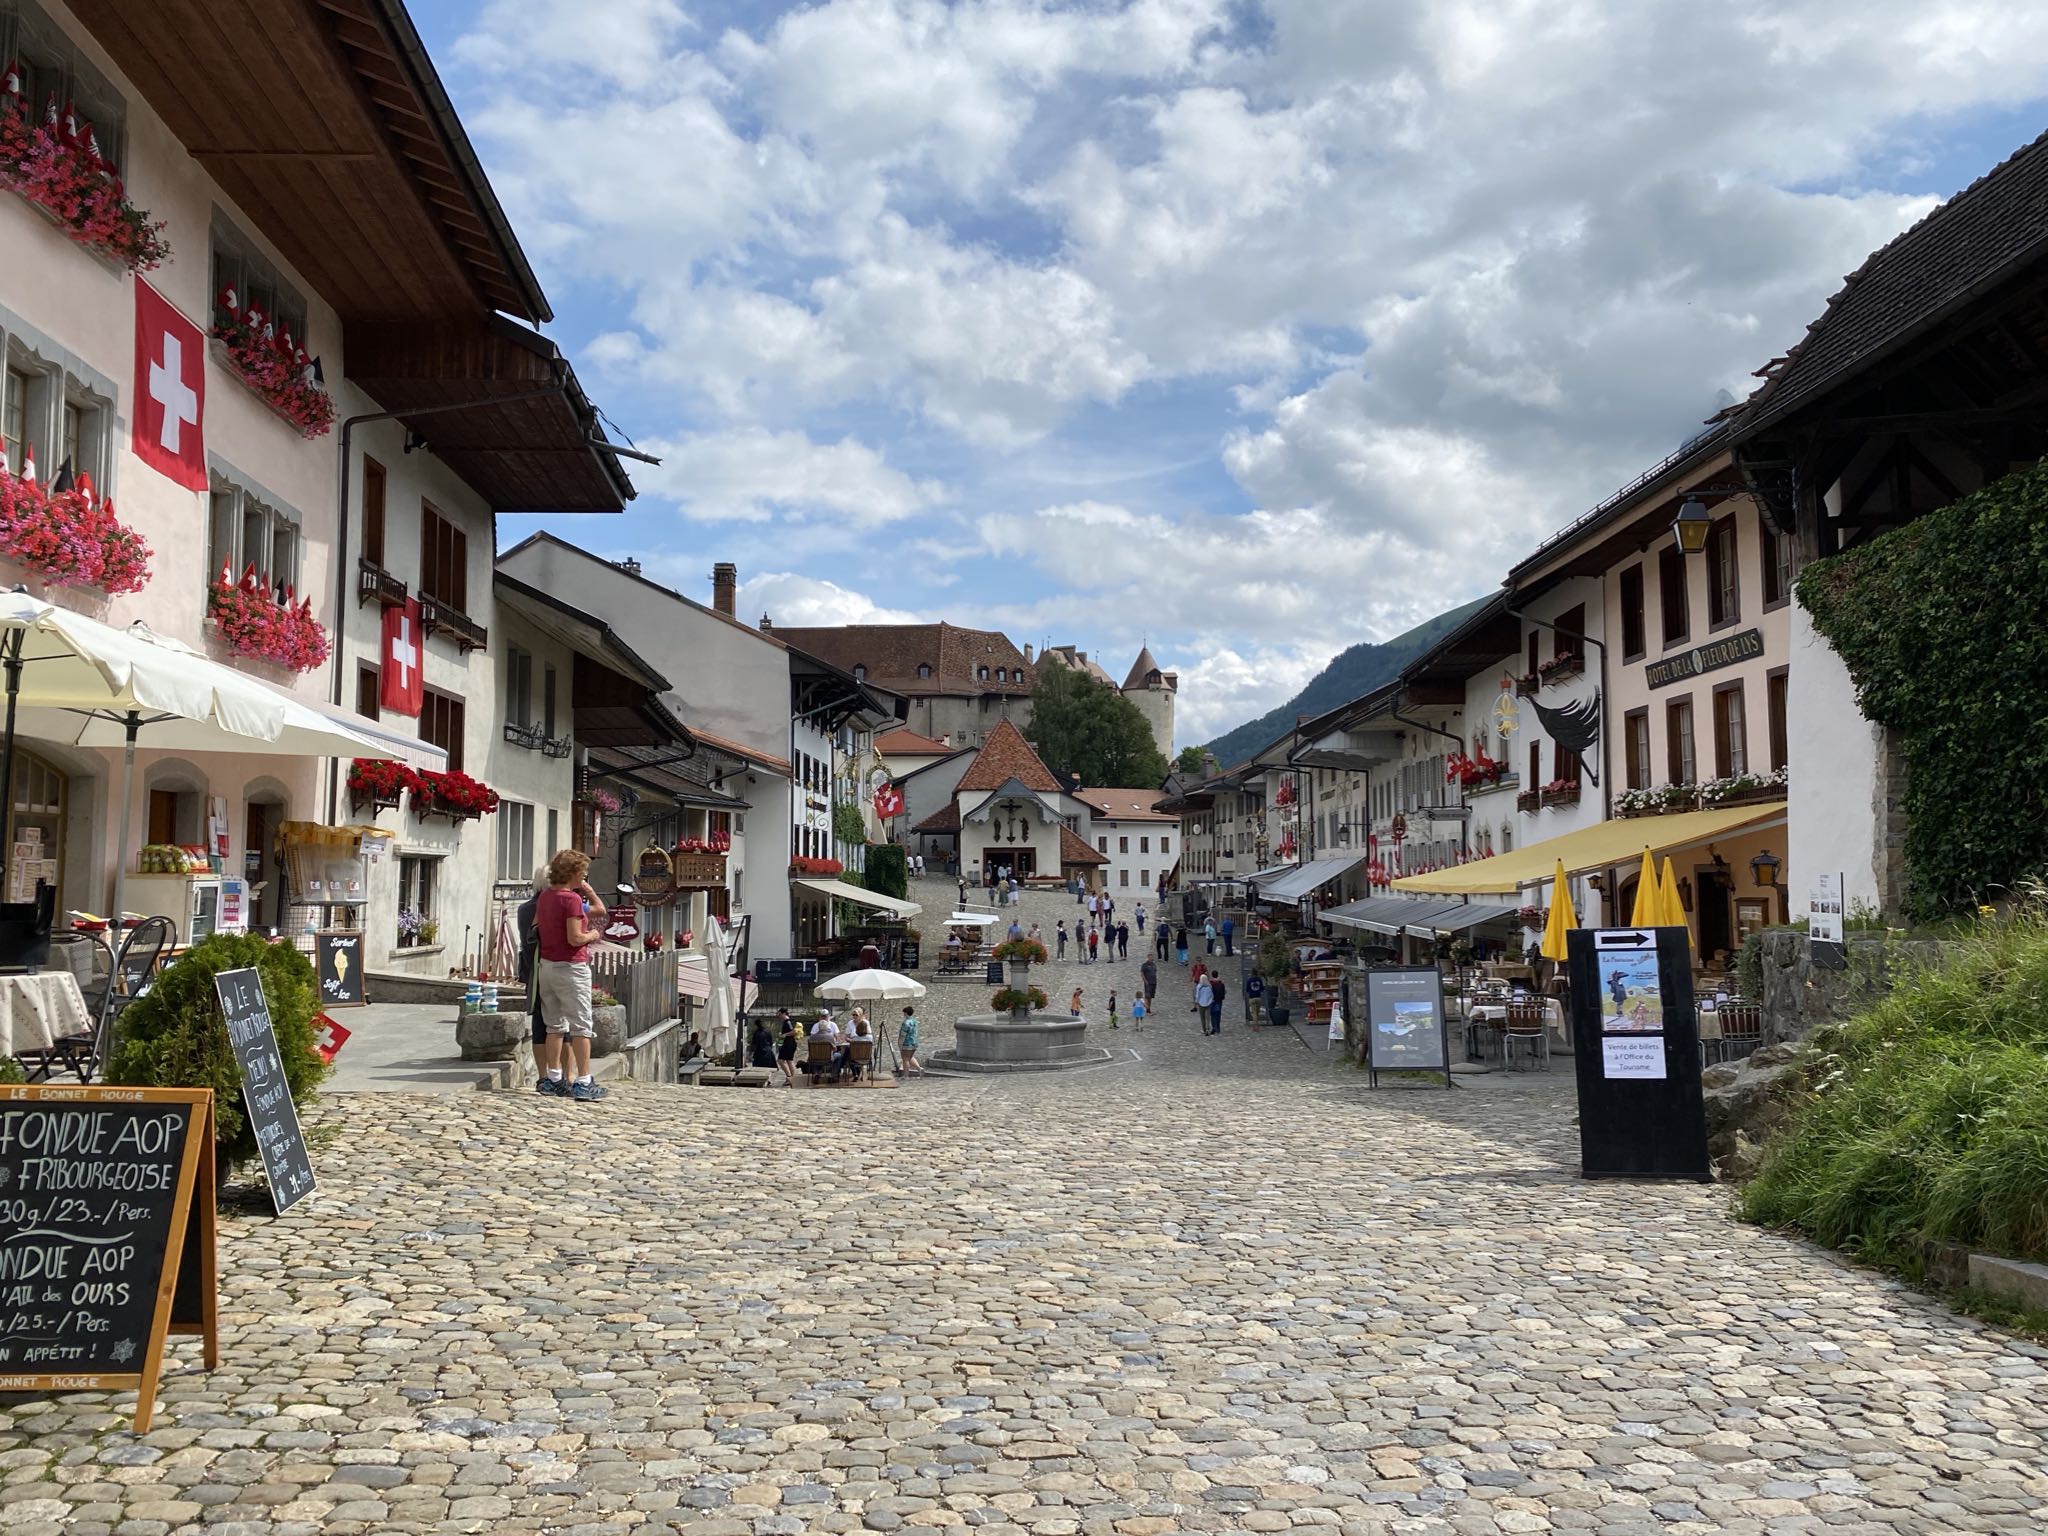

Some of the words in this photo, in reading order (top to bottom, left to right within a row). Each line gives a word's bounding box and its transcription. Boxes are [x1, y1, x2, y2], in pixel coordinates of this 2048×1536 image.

[1648, 664, 1673, 686] HOTEL
[1672, 660, 1683, 677] DE
[1682, 657, 1694, 674] LA
[1701, 645, 1730, 668] FLEUR
[1728, 640, 1741, 658] DE
[1740, 633, 1759, 655] LYS
[330, 937, 357, 947] Sorbet
[233, 981, 250, 1011] LE
[323, 978, 340, 992] Soft
[10, 1088, 27, 1100] LE
[40, 1088, 88, 1100] BONNET
[100, 1090, 144, 1101] ROUGE
[0, 1111, 113, 1155] FONDUE
[108, 1113, 184, 1155] AOP
[18, 1157, 173, 1191] FRIBOURGEOISE
[0, 1246, 73, 1280] NDUE
[81, 1245, 135, 1276] AOP
[42, 1285, 62, 1302] des
[71, 1281, 130, 1306] OURS
[23, 1344, 84, 1362] APPÉTIT
[52, 1377, 100, 1388] ROUGE
